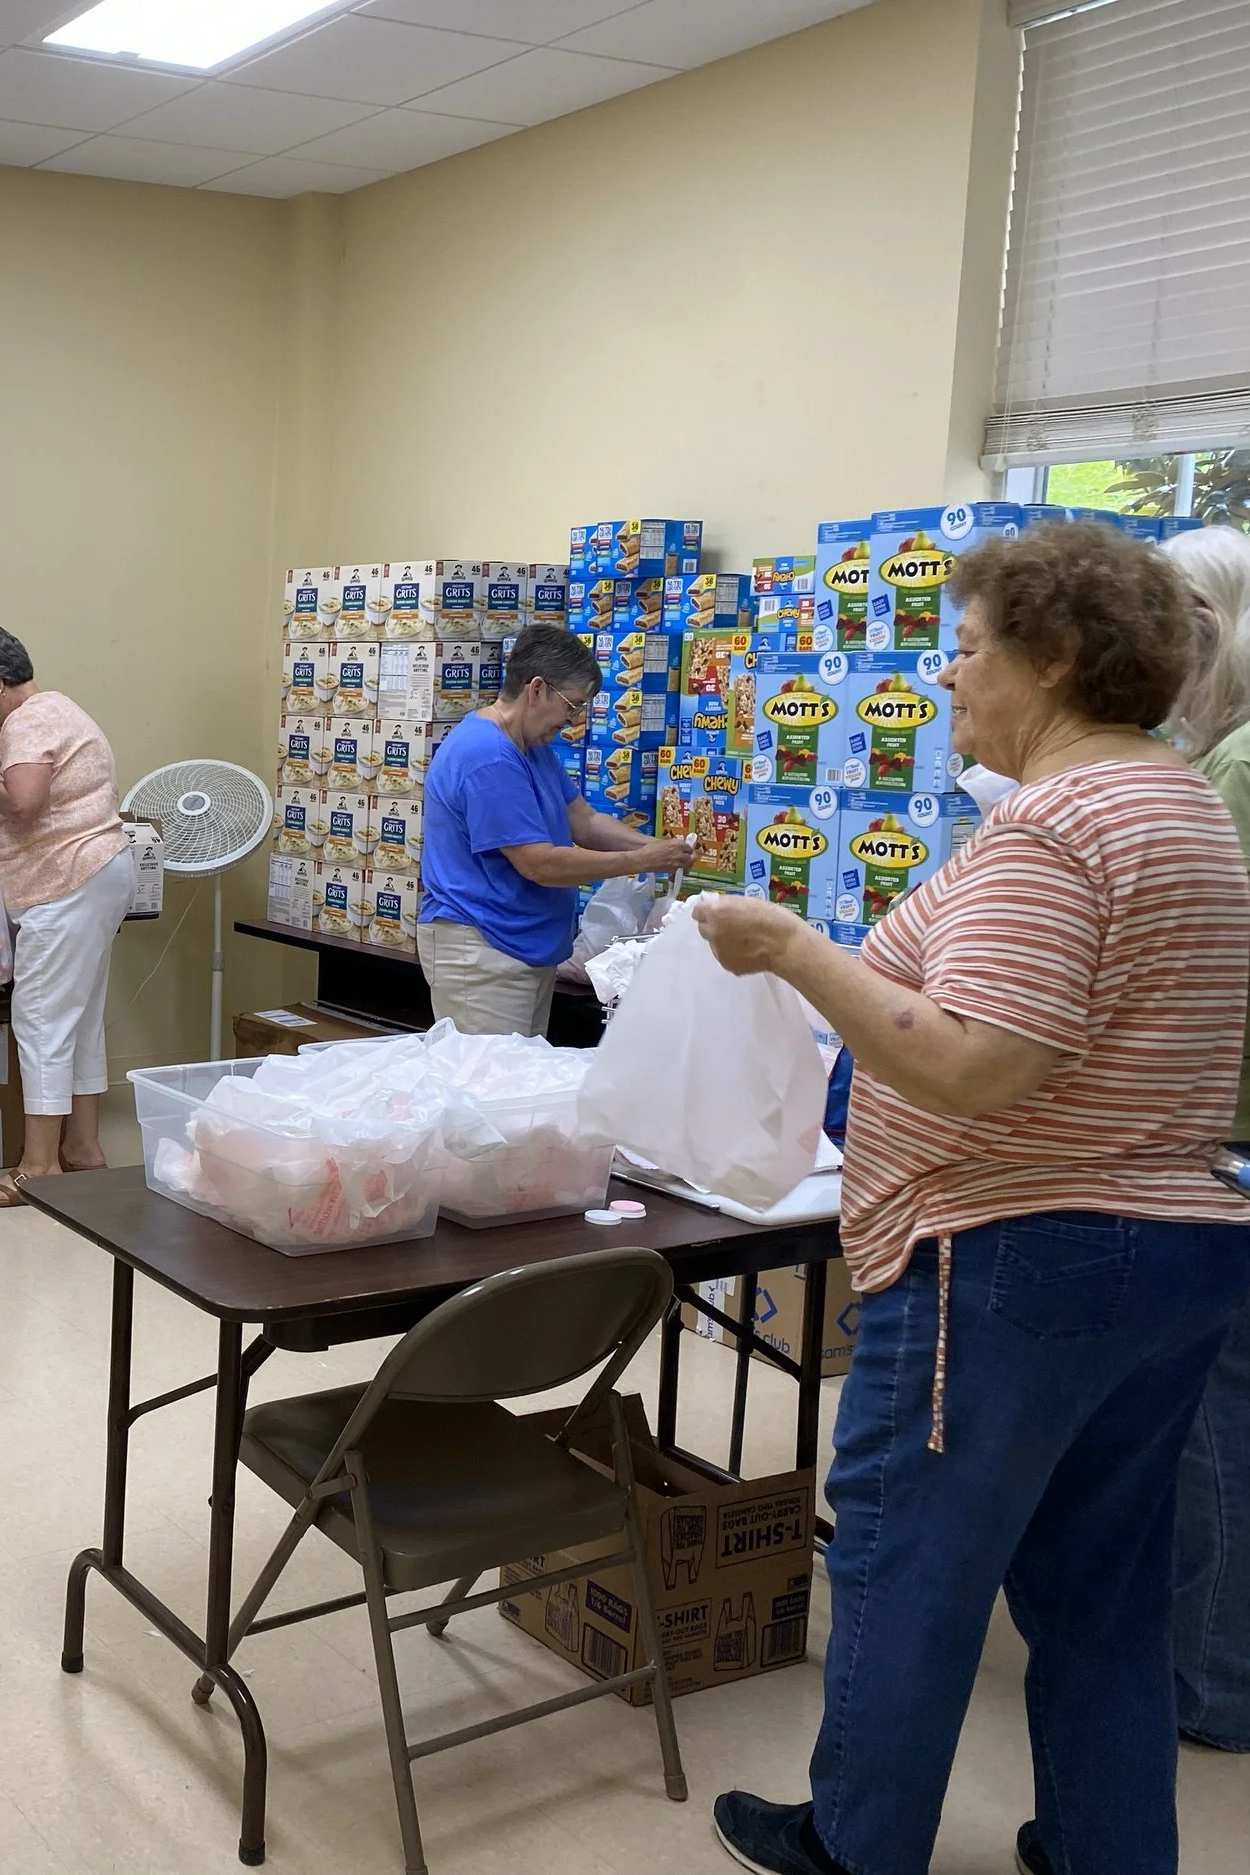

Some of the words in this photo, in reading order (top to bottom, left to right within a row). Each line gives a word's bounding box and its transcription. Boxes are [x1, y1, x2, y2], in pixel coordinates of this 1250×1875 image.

[947, 508, 966, 525] 90
[1005, 526, 1015, 537] 90
[831, 570, 869, 584] MOT
[298, 593, 316, 602] GRITS
[345, 590, 364, 600] GRITS
[396, 588, 417, 599] GRITS
[446, 588, 470, 597] GRITS
[491, 589, 515, 599] GRITS
[538, 590, 562, 600] GRITS
[735, 636, 746, 645] 60
[800, 636, 812, 645] 60
[825, 656, 841, 671] 90
[923, 654, 941, 670] 90
[295, 668, 312, 677] GRITS
[343, 668, 361, 677] GRITS
[445, 668, 469, 678] GRITS
[694, 713, 727, 729] HEWY
[291, 740, 308, 749] GRITS
[337, 743, 355, 753] GRITS
[387, 746, 406, 756] GRITS
[661, 750, 671, 758] 60
[694, 759, 705, 768] 60
[815, 791, 831, 805] 90
[914, 798, 932, 812] 90
[287, 810, 303, 820] GRITS
[333, 816, 350, 826] GRITS
[384, 822, 402, 833] GRITS
[328, 888, 345, 898] GRITS
[379, 898, 398, 909] GRITS
[749, 1505, 801, 1524] CARRY-OUT
[722, 1517, 747, 1531] BAGS
[721, 1518, 802, 1557] T-SHIRT
[657, 1605, 708, 1628] -SHIRT
